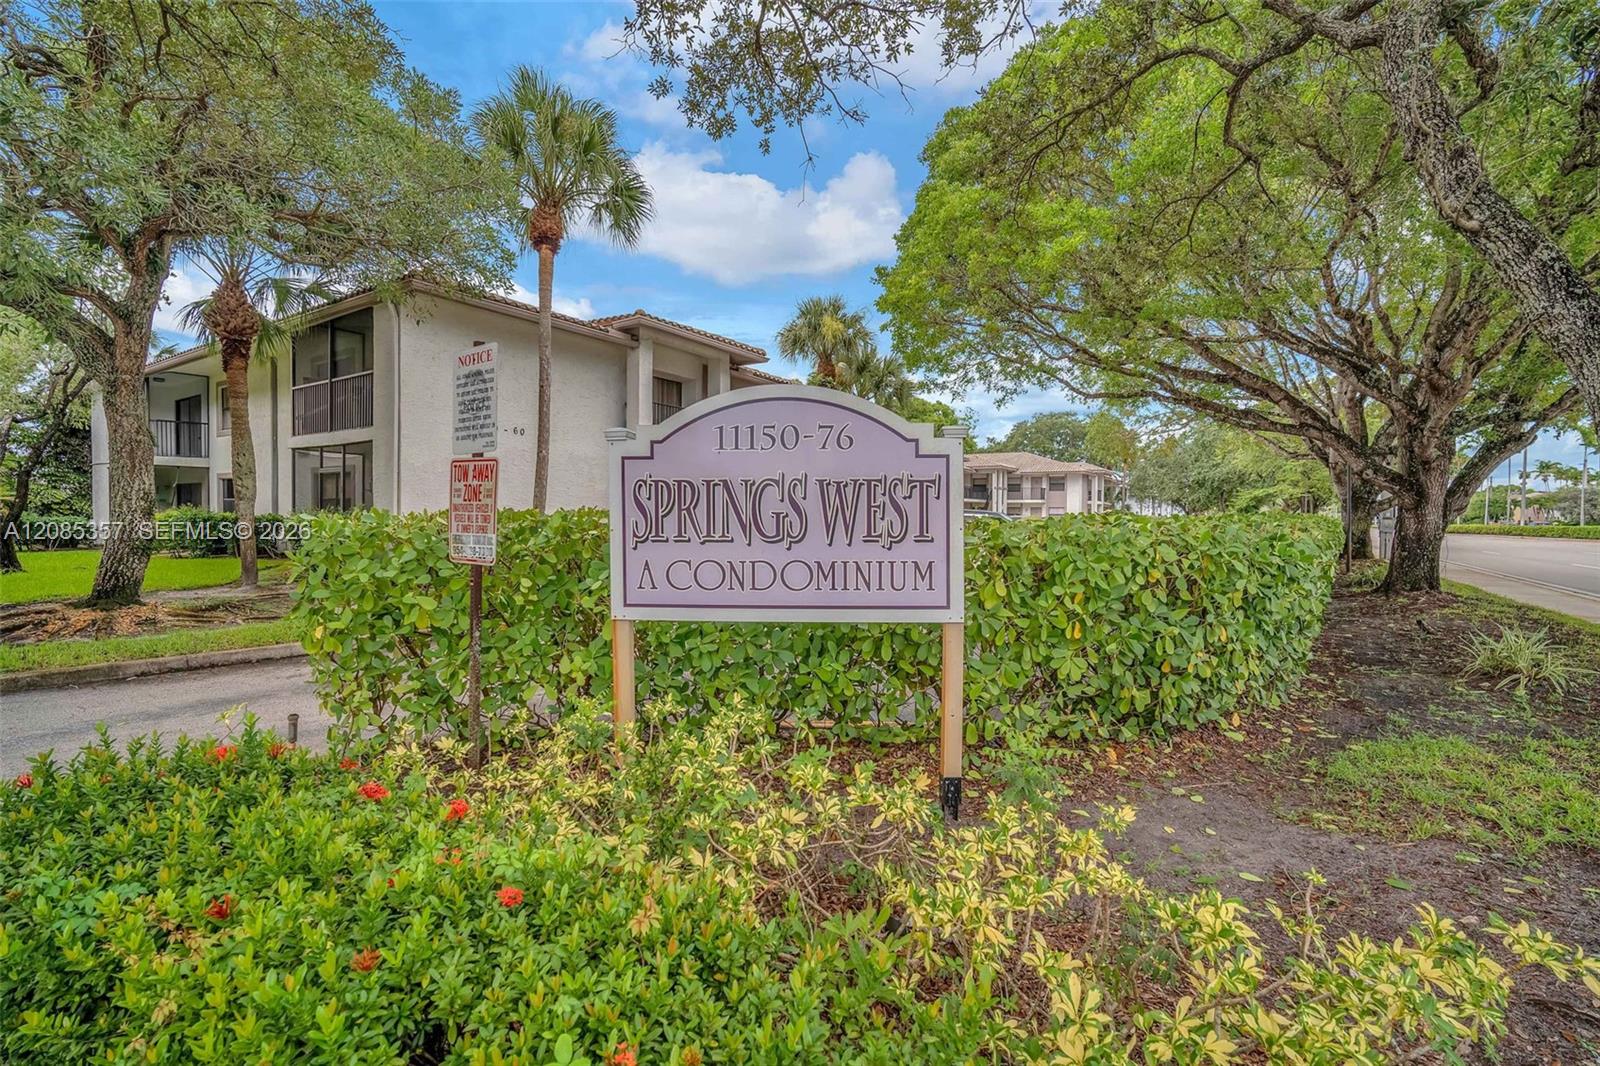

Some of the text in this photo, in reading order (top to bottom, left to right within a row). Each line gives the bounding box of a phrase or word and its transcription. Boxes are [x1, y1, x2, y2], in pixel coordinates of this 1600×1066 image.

[458, 349, 493, 368] NOTICE
[714, 423, 855, 451] 11150-76
[454, 464, 495, 482] TOW AWAY
[463, 484, 482, 502] ZONE
[631, 471, 940, 550] SPRINGS WEST
[637, 559, 936, 592] A CONDOMINIUM
